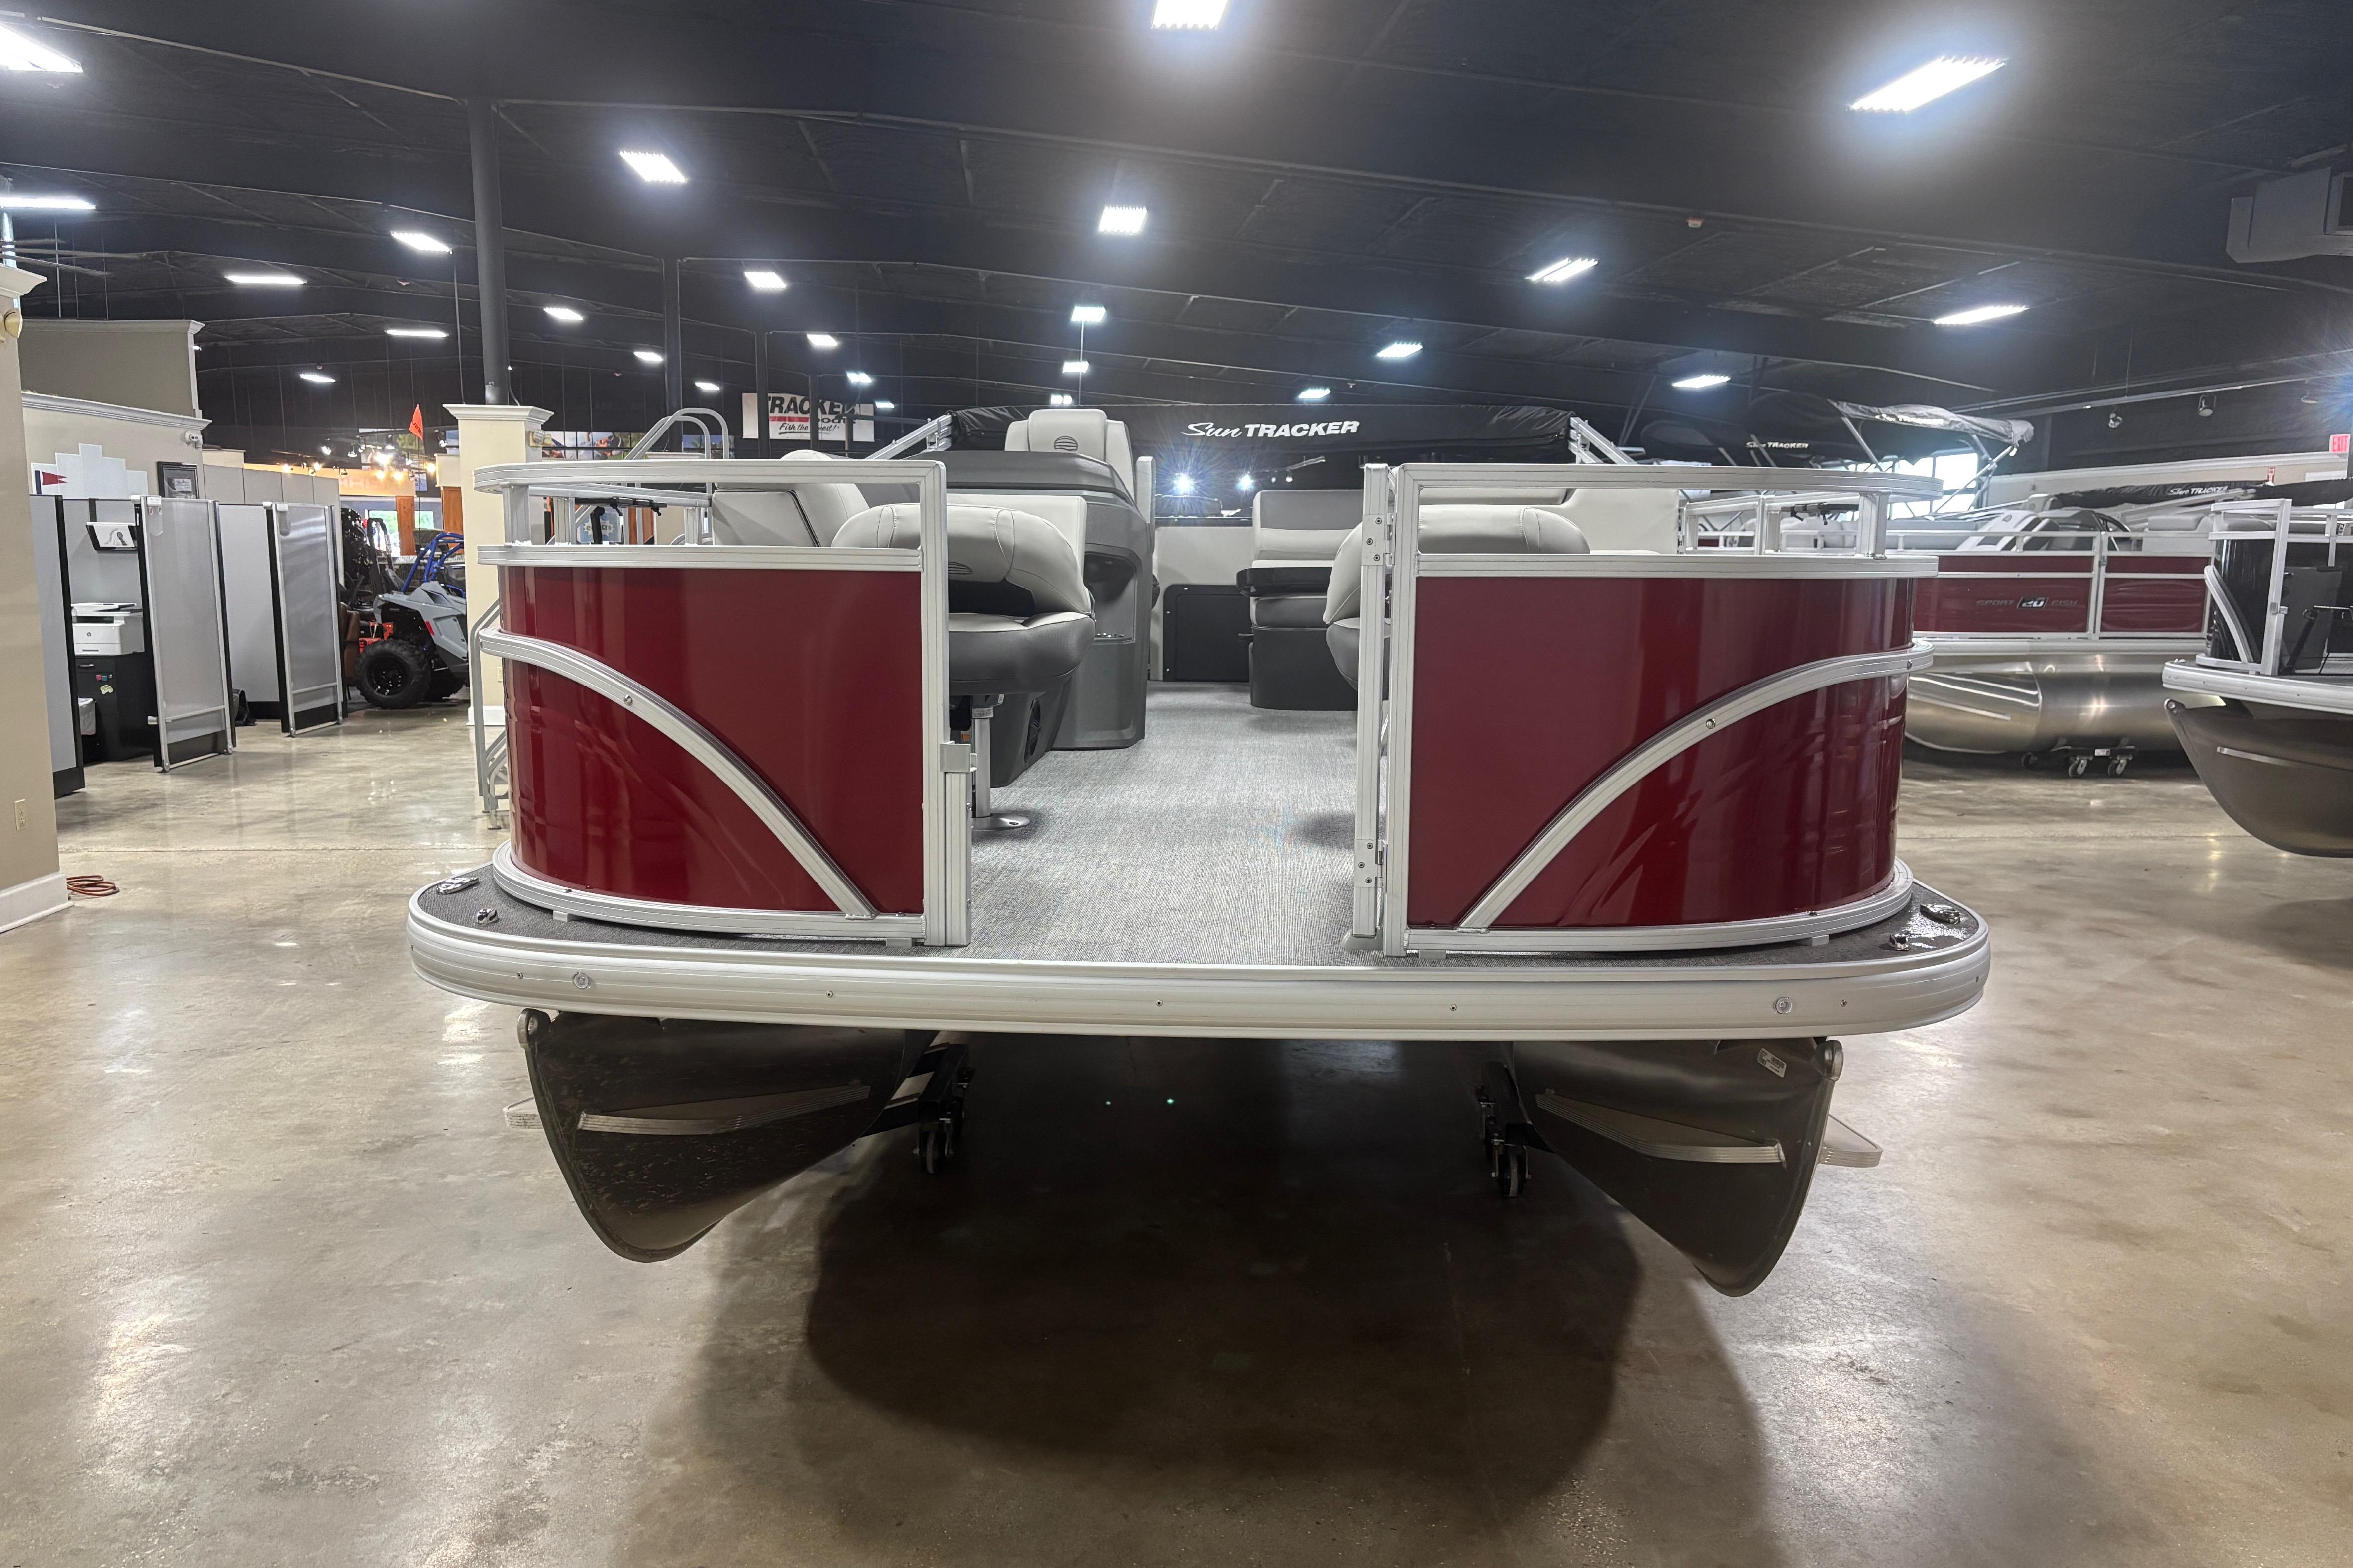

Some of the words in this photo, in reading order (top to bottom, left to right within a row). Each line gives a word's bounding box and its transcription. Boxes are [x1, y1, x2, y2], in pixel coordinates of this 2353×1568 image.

[1181, 422, 1242, 437] Sun
[1244, 421, 1360, 437] TRACKER
[2022, 597, 2045, 607] 20
